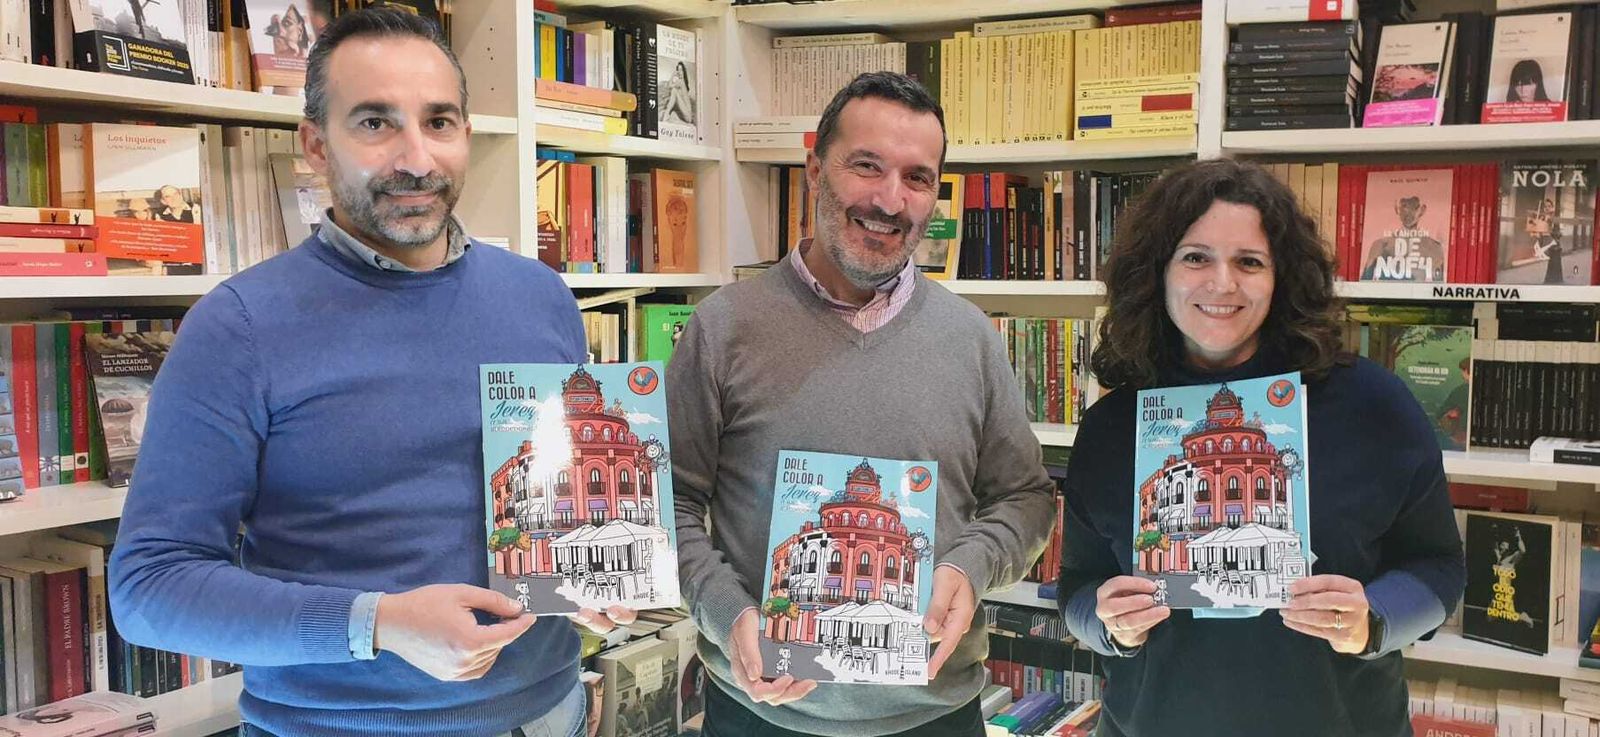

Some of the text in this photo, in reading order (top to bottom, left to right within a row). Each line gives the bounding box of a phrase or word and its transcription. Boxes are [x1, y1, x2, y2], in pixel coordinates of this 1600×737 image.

[128, 43, 174, 58] GANADORA DEL
[129, 51, 152, 61] PREMIO
[153, 55, 176, 65] BOOKER
[107, 134, 167, 145] Los inquietos
[660, 128, 694, 139] Gay Talese
[1512, 170, 1586, 187] NOLA
[1393, 228, 1429, 238] CANCIÓN
[1395, 237, 1421, 257] DE
[1372, 255, 1433, 282] NOF4
[1433, 287, 1520, 300] NARRATIVA
[114, 364, 152, 372] CUCHILLOS
[487, 371, 515, 385] DALE
[489, 386, 536, 400] COLOR A
[1142, 395, 1166, 409] DALE
[1142, 407, 1183, 422] COLOR A
[784, 457, 808, 471] DALE
[783, 471, 824, 486] COLOR A
[1492, 565, 1517, 579] TODO
[1493, 583, 1515, 595] ODIO
[60, 584, 72, 649] EL PADRE BROWN
[1487, 607, 1520, 621] DENTRO
